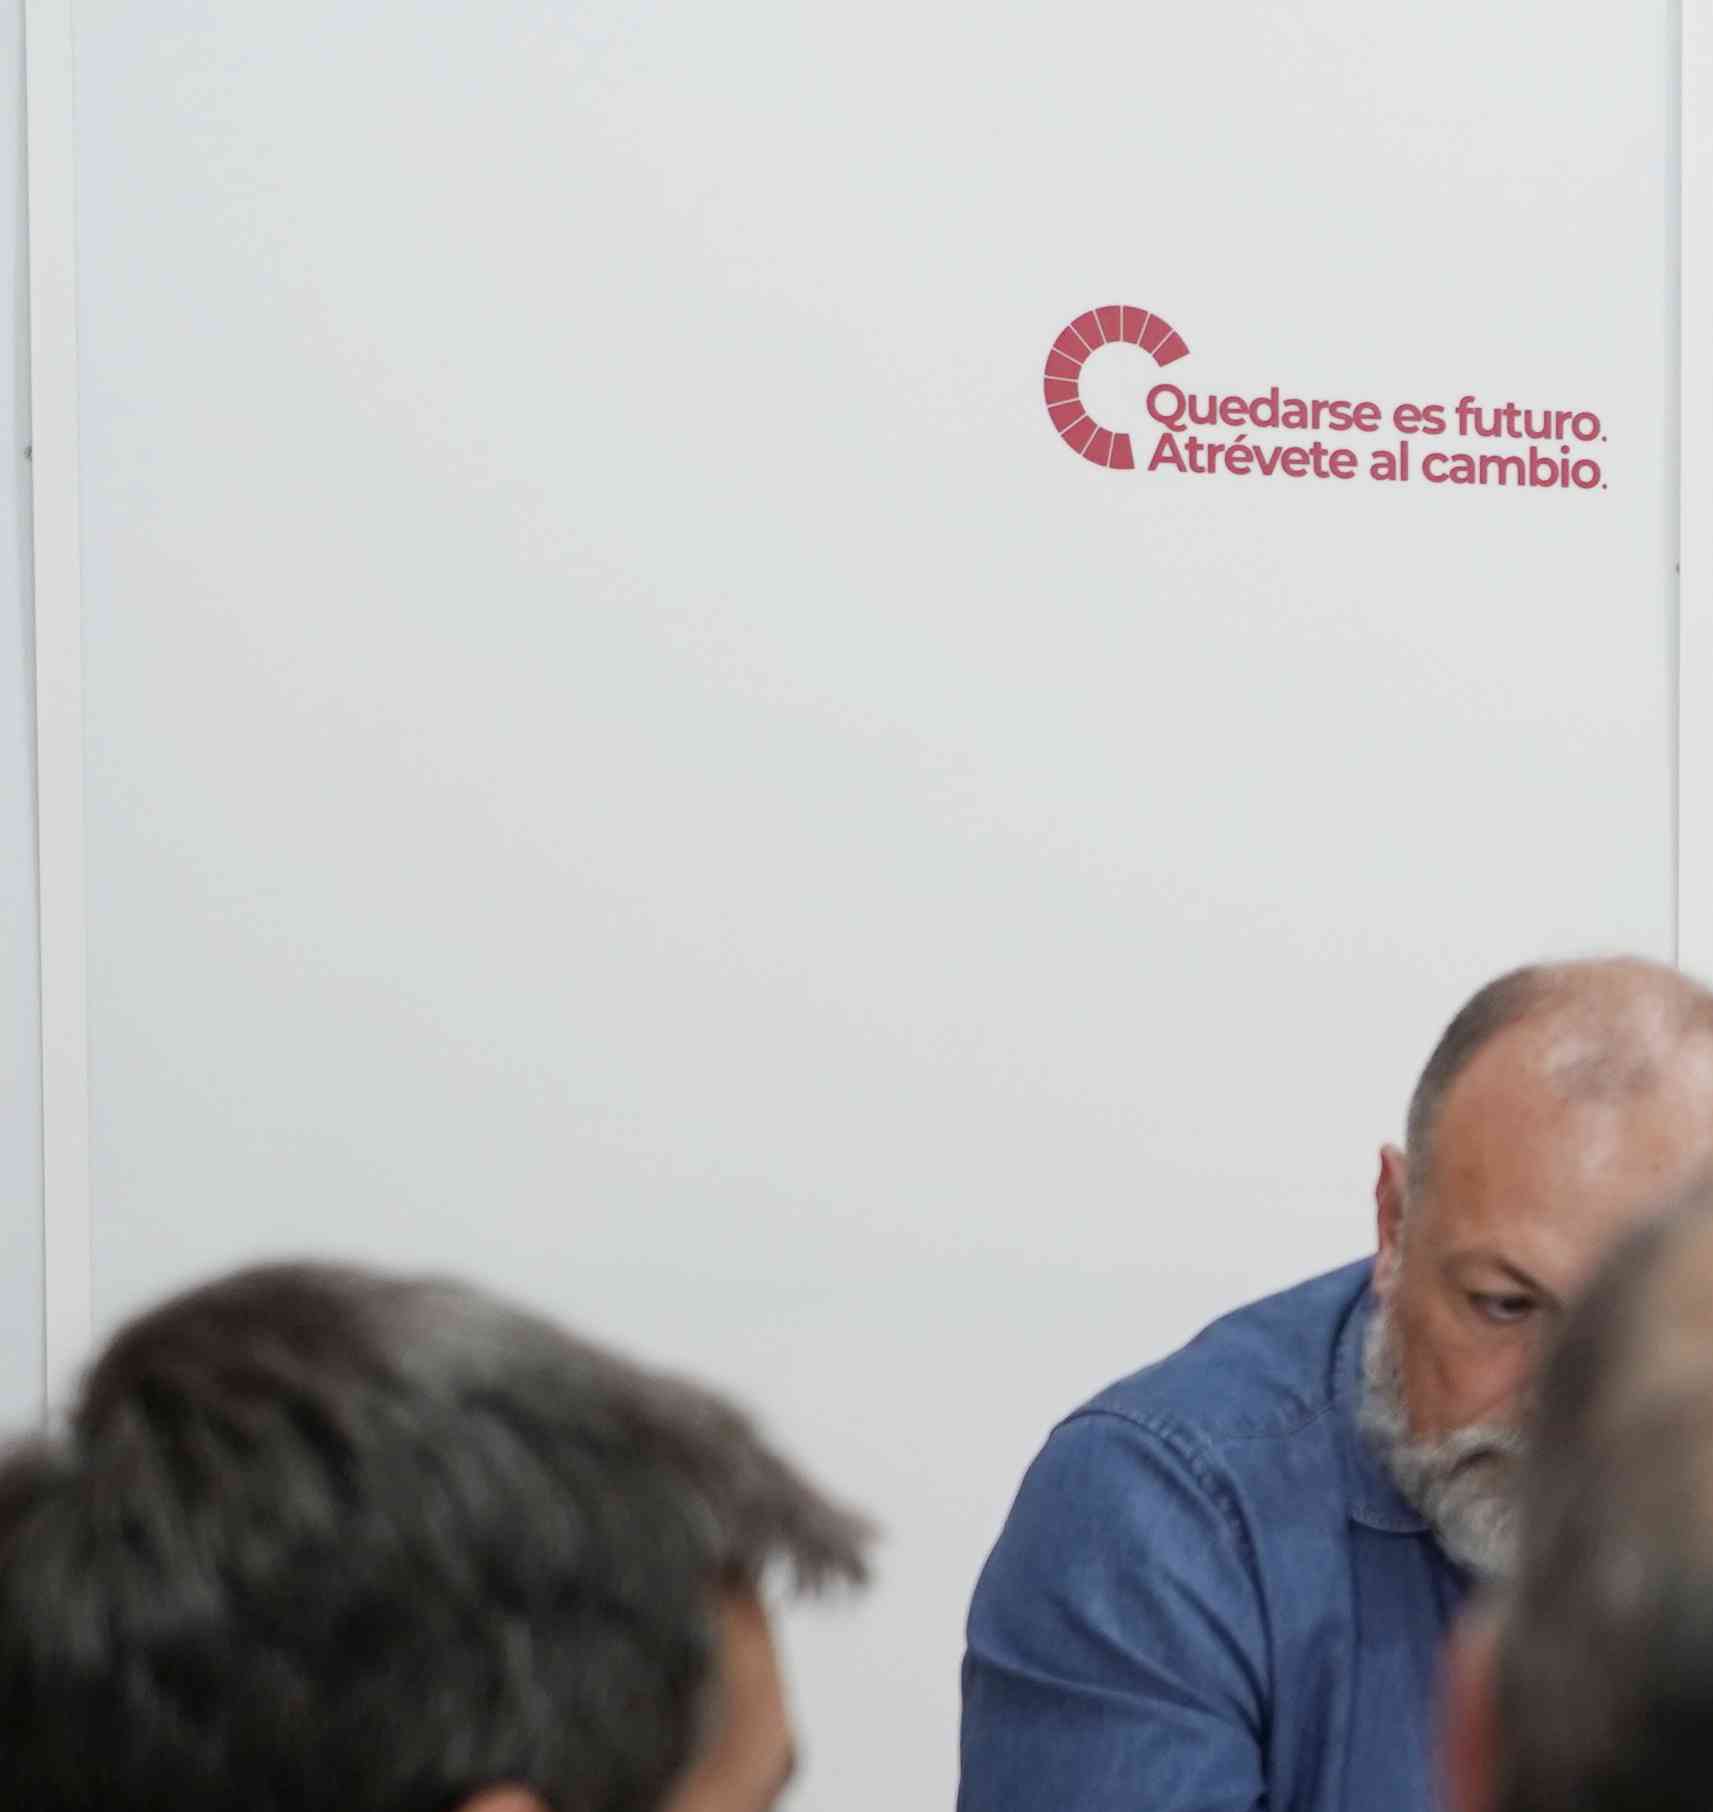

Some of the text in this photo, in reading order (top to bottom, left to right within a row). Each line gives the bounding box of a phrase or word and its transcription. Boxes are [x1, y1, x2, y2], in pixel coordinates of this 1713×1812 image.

[1145, 383, 1608, 443] Quedarse es futuro.
[1147, 431, 1608, 490] Atrévete al cambio.
